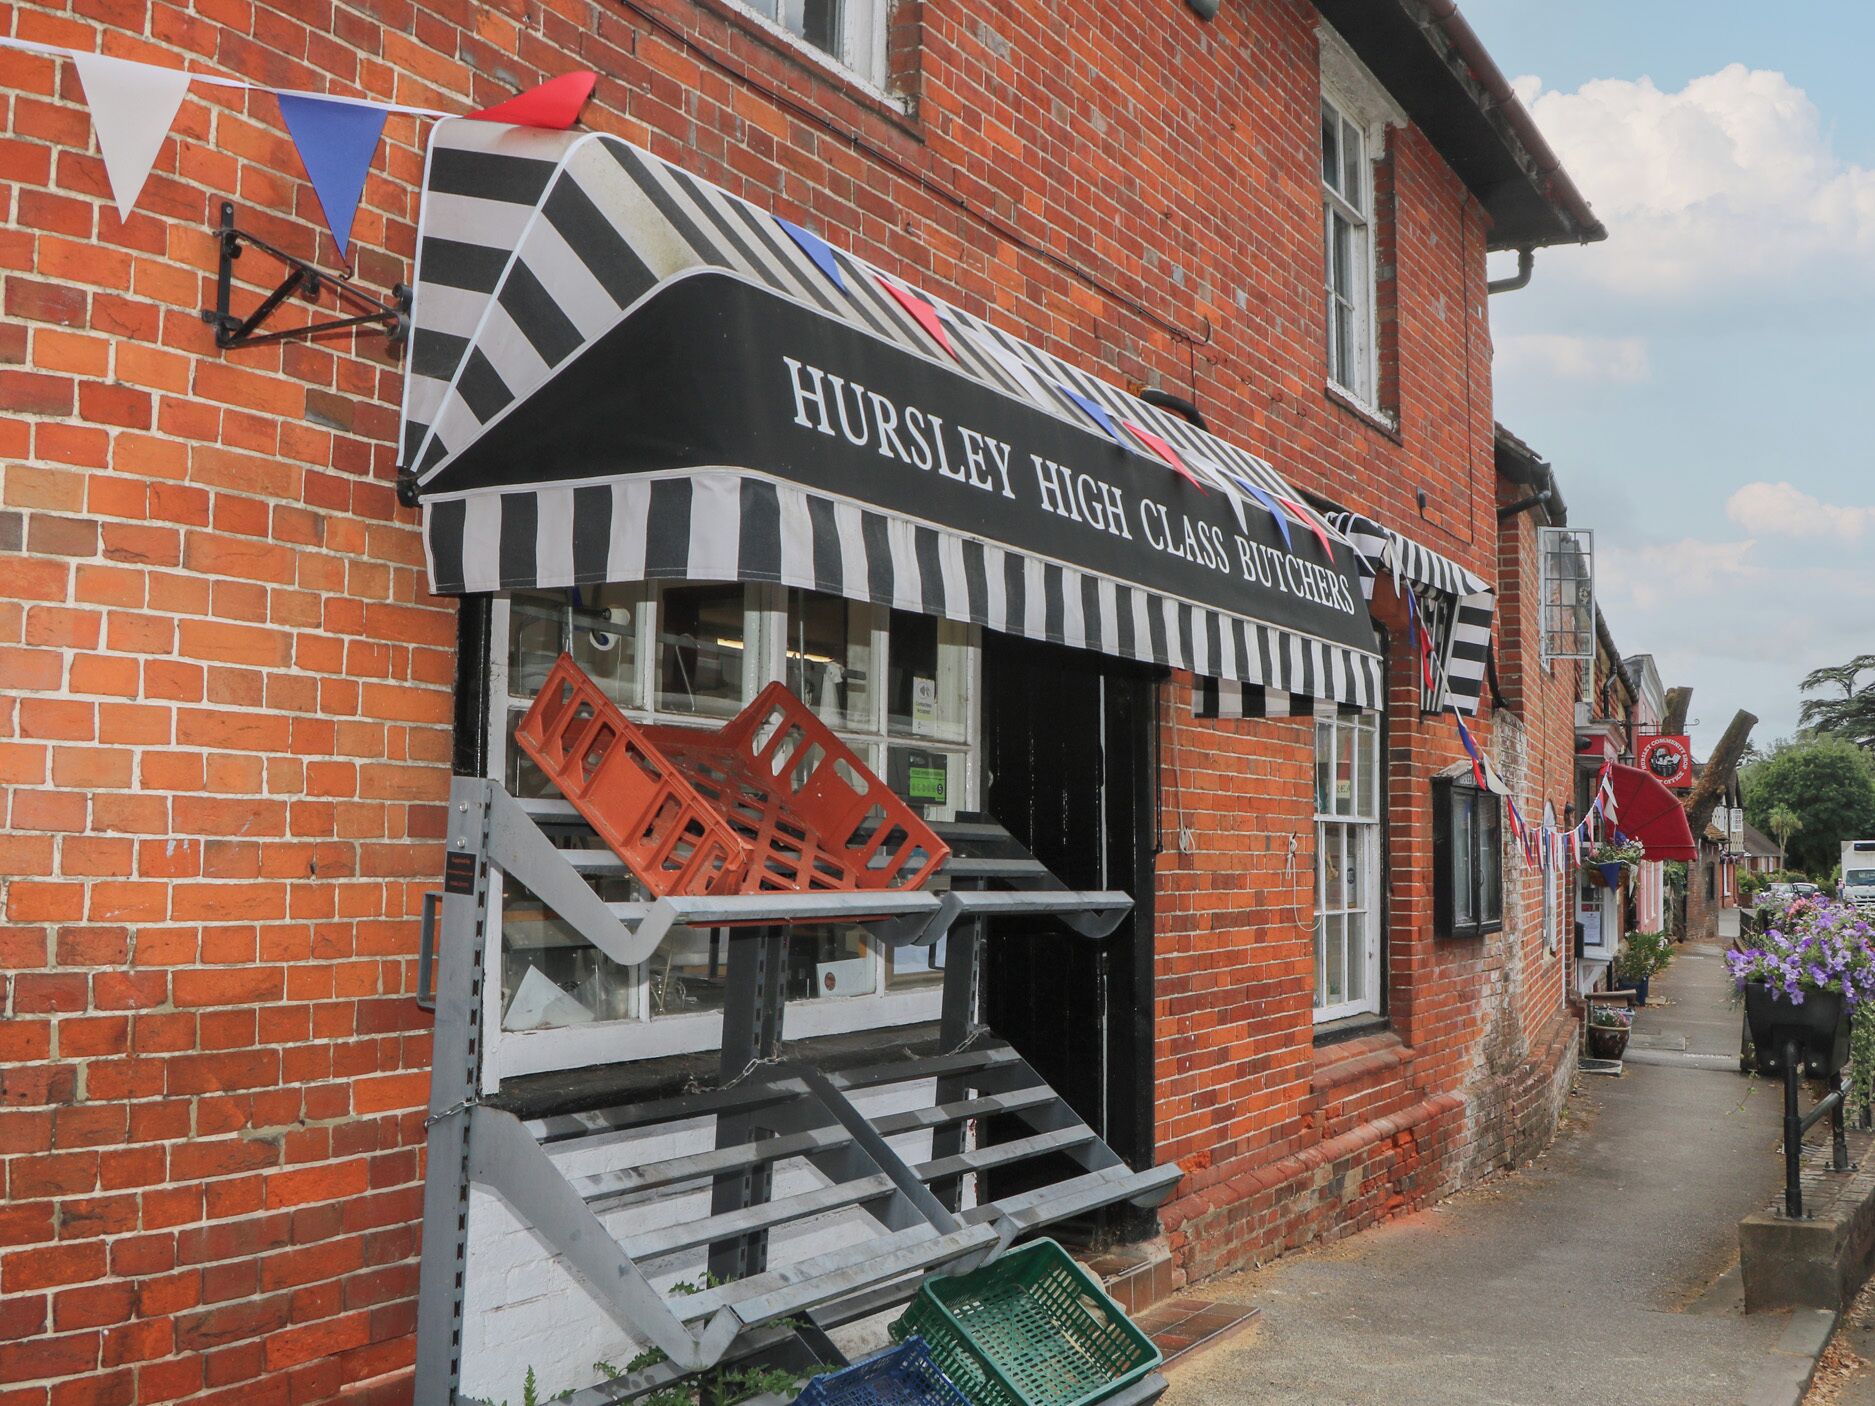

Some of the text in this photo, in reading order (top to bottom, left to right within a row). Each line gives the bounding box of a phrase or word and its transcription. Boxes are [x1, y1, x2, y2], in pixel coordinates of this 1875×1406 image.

[783, 356, 1355, 616] HURSLEY HIGH CLASS BUTCHERS
[1651, 738, 1686, 754] COMMUNITY
[1664, 771, 1684, 784] OFFICE
